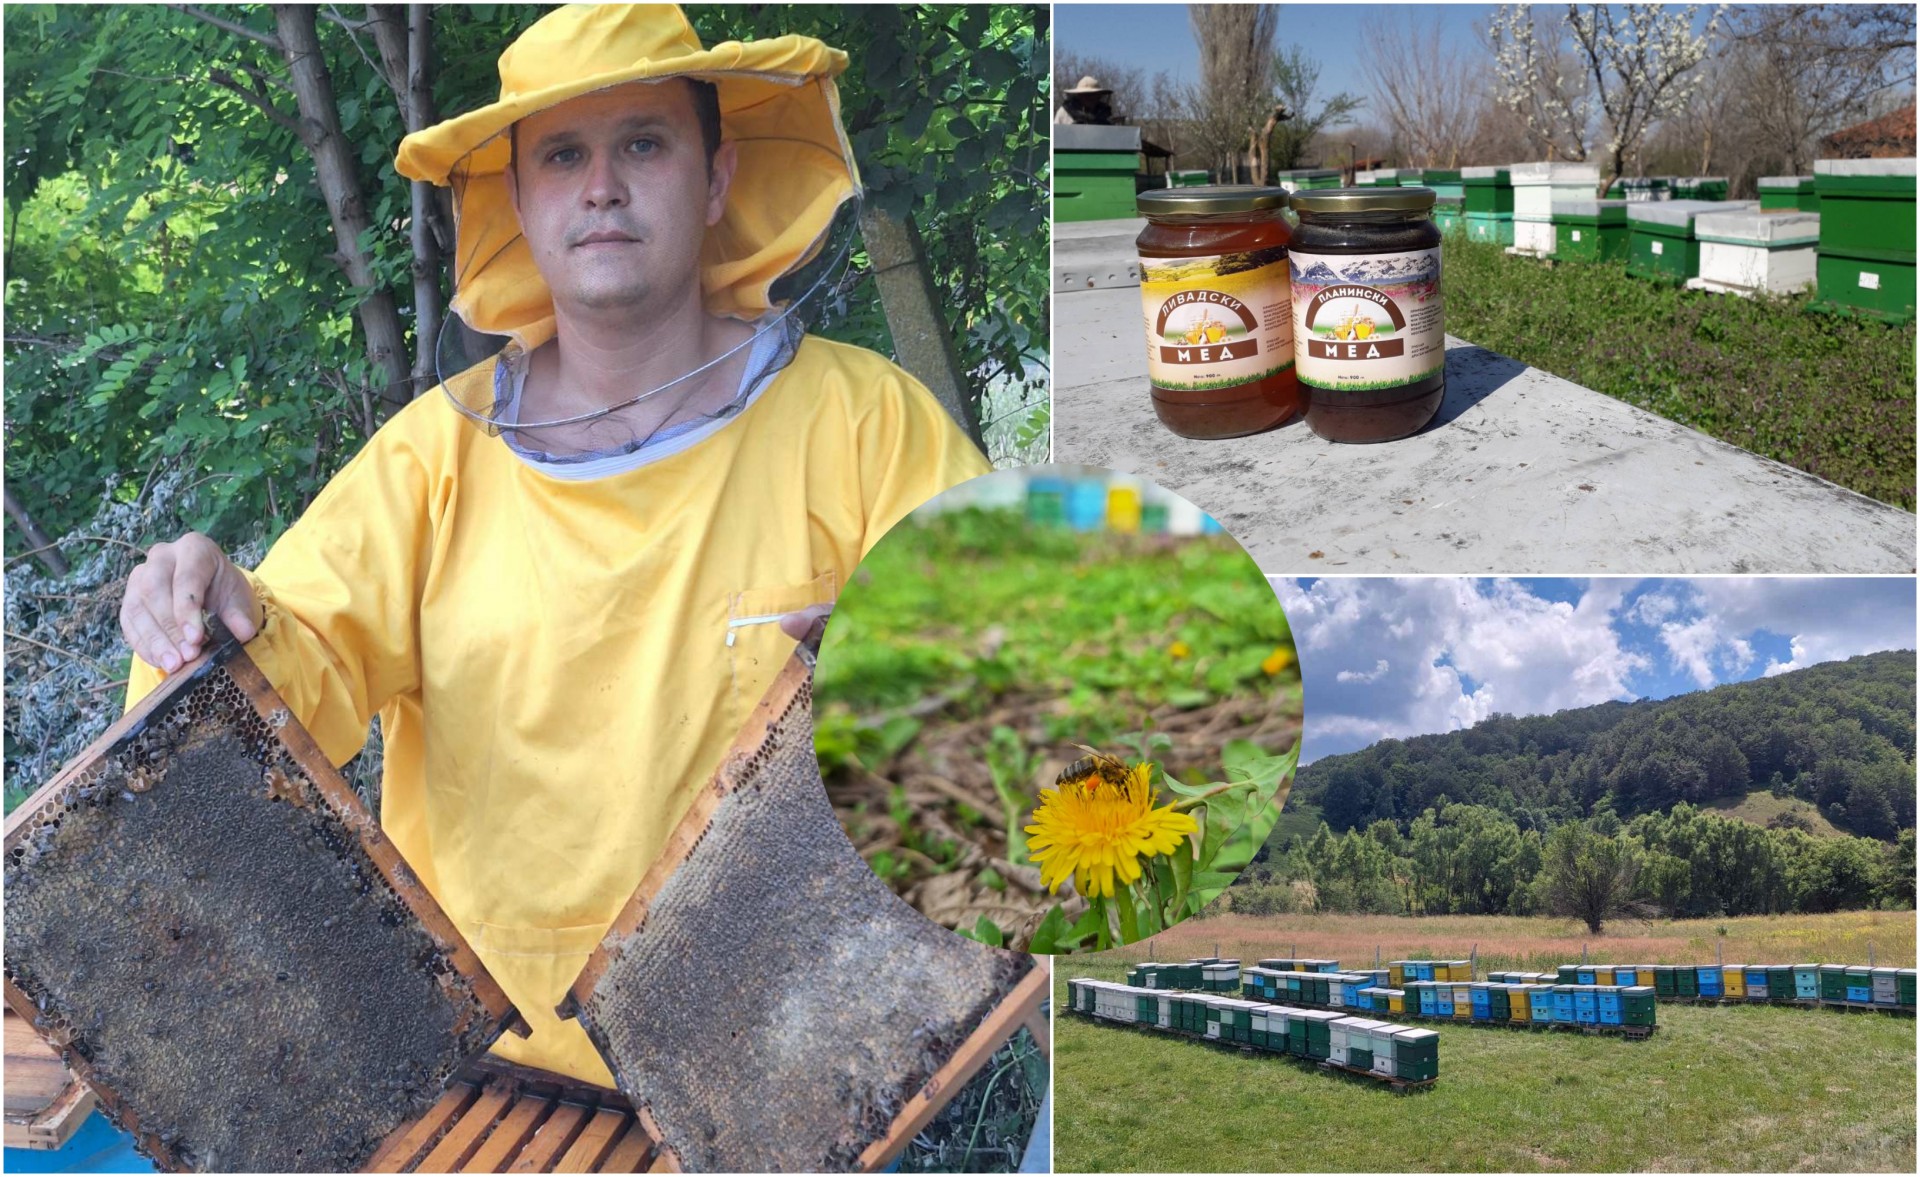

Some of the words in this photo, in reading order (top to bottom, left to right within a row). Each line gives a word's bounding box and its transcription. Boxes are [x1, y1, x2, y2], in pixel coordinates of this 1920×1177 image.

[1161, 291, 1242, 317] ЛИВАДСКИ
[1317, 287, 1389, 306] ПЛАНИНСКИ
[1177, 346, 1234, 362] МЕД
[1325, 343, 1381, 359] МЕД
